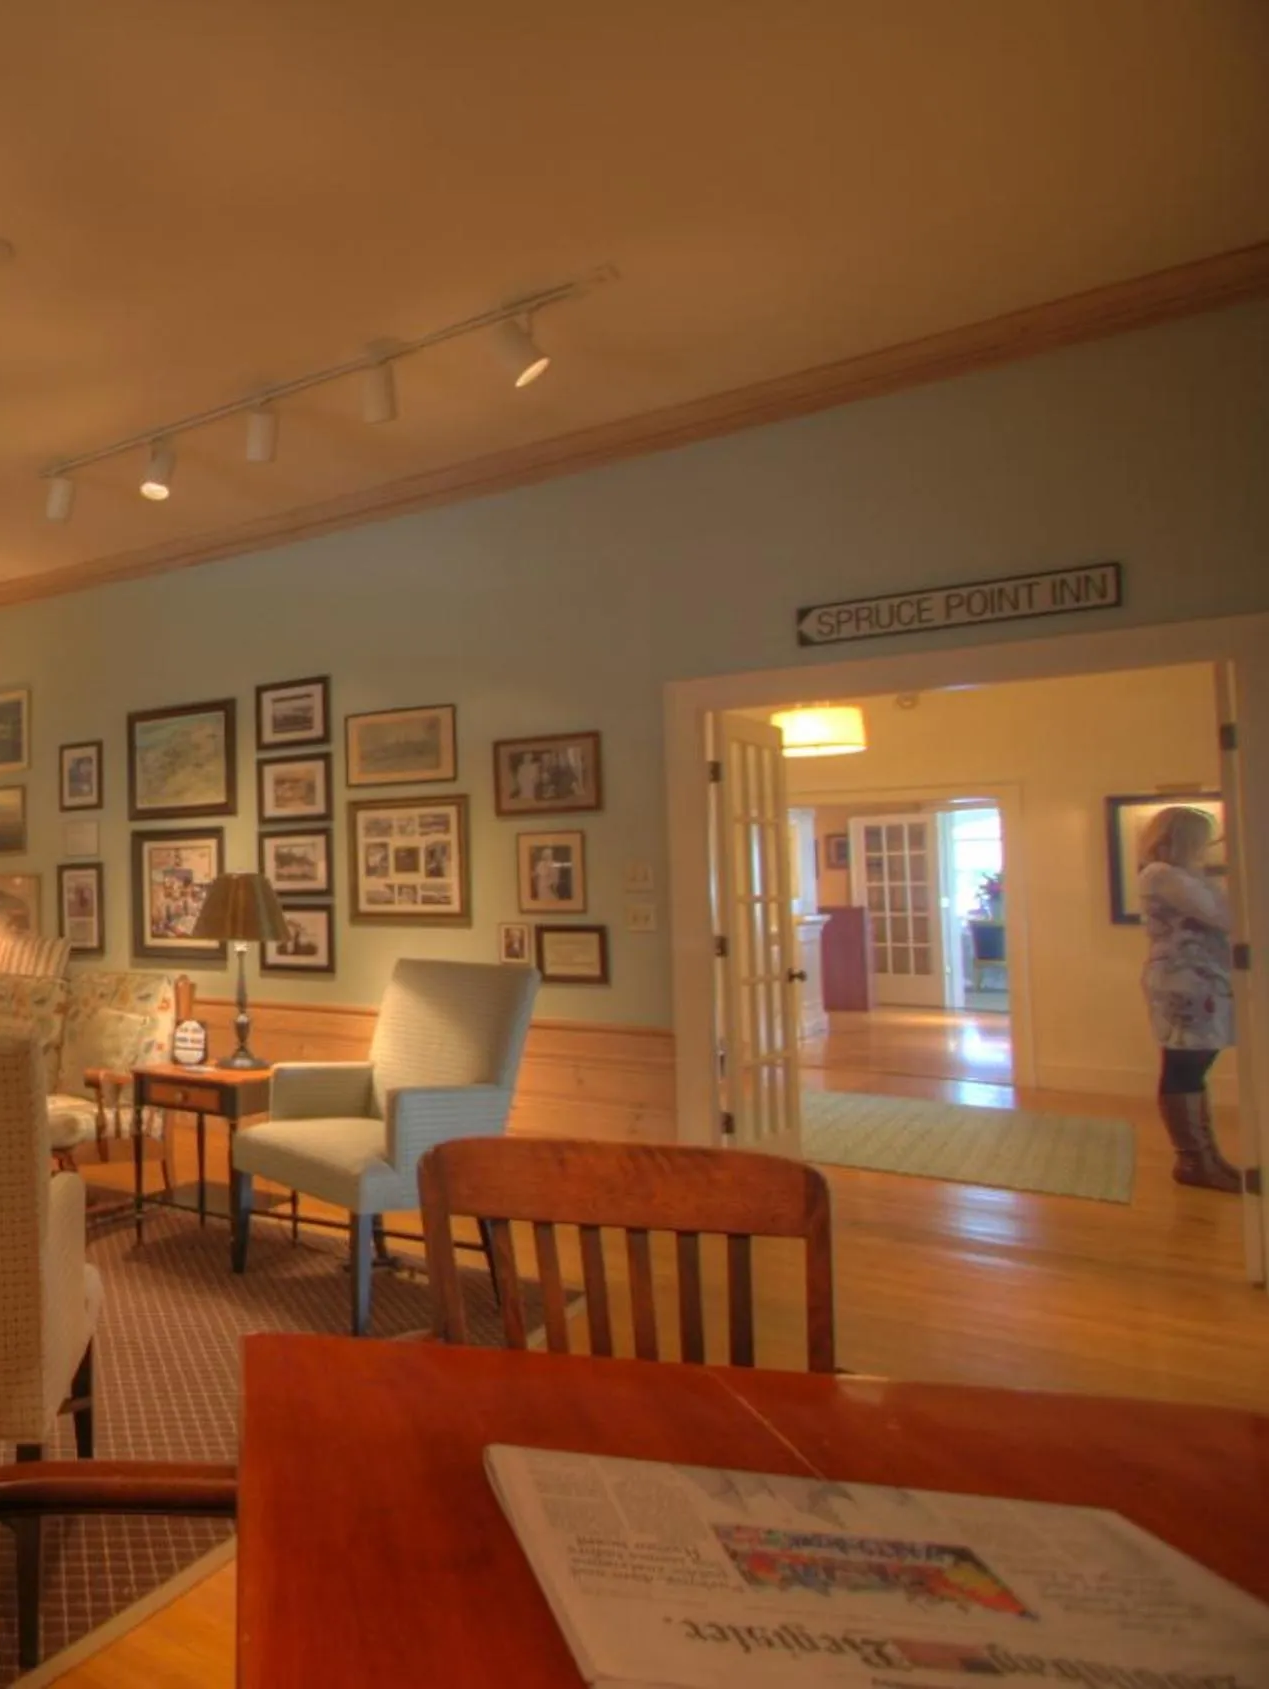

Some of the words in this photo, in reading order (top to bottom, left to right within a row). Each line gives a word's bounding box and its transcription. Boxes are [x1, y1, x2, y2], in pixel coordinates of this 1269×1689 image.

[816, 597, 935, 638] SPRUCE
[943, 581, 1041, 621] POINT
[1050, 572, 1109, 607] INN
